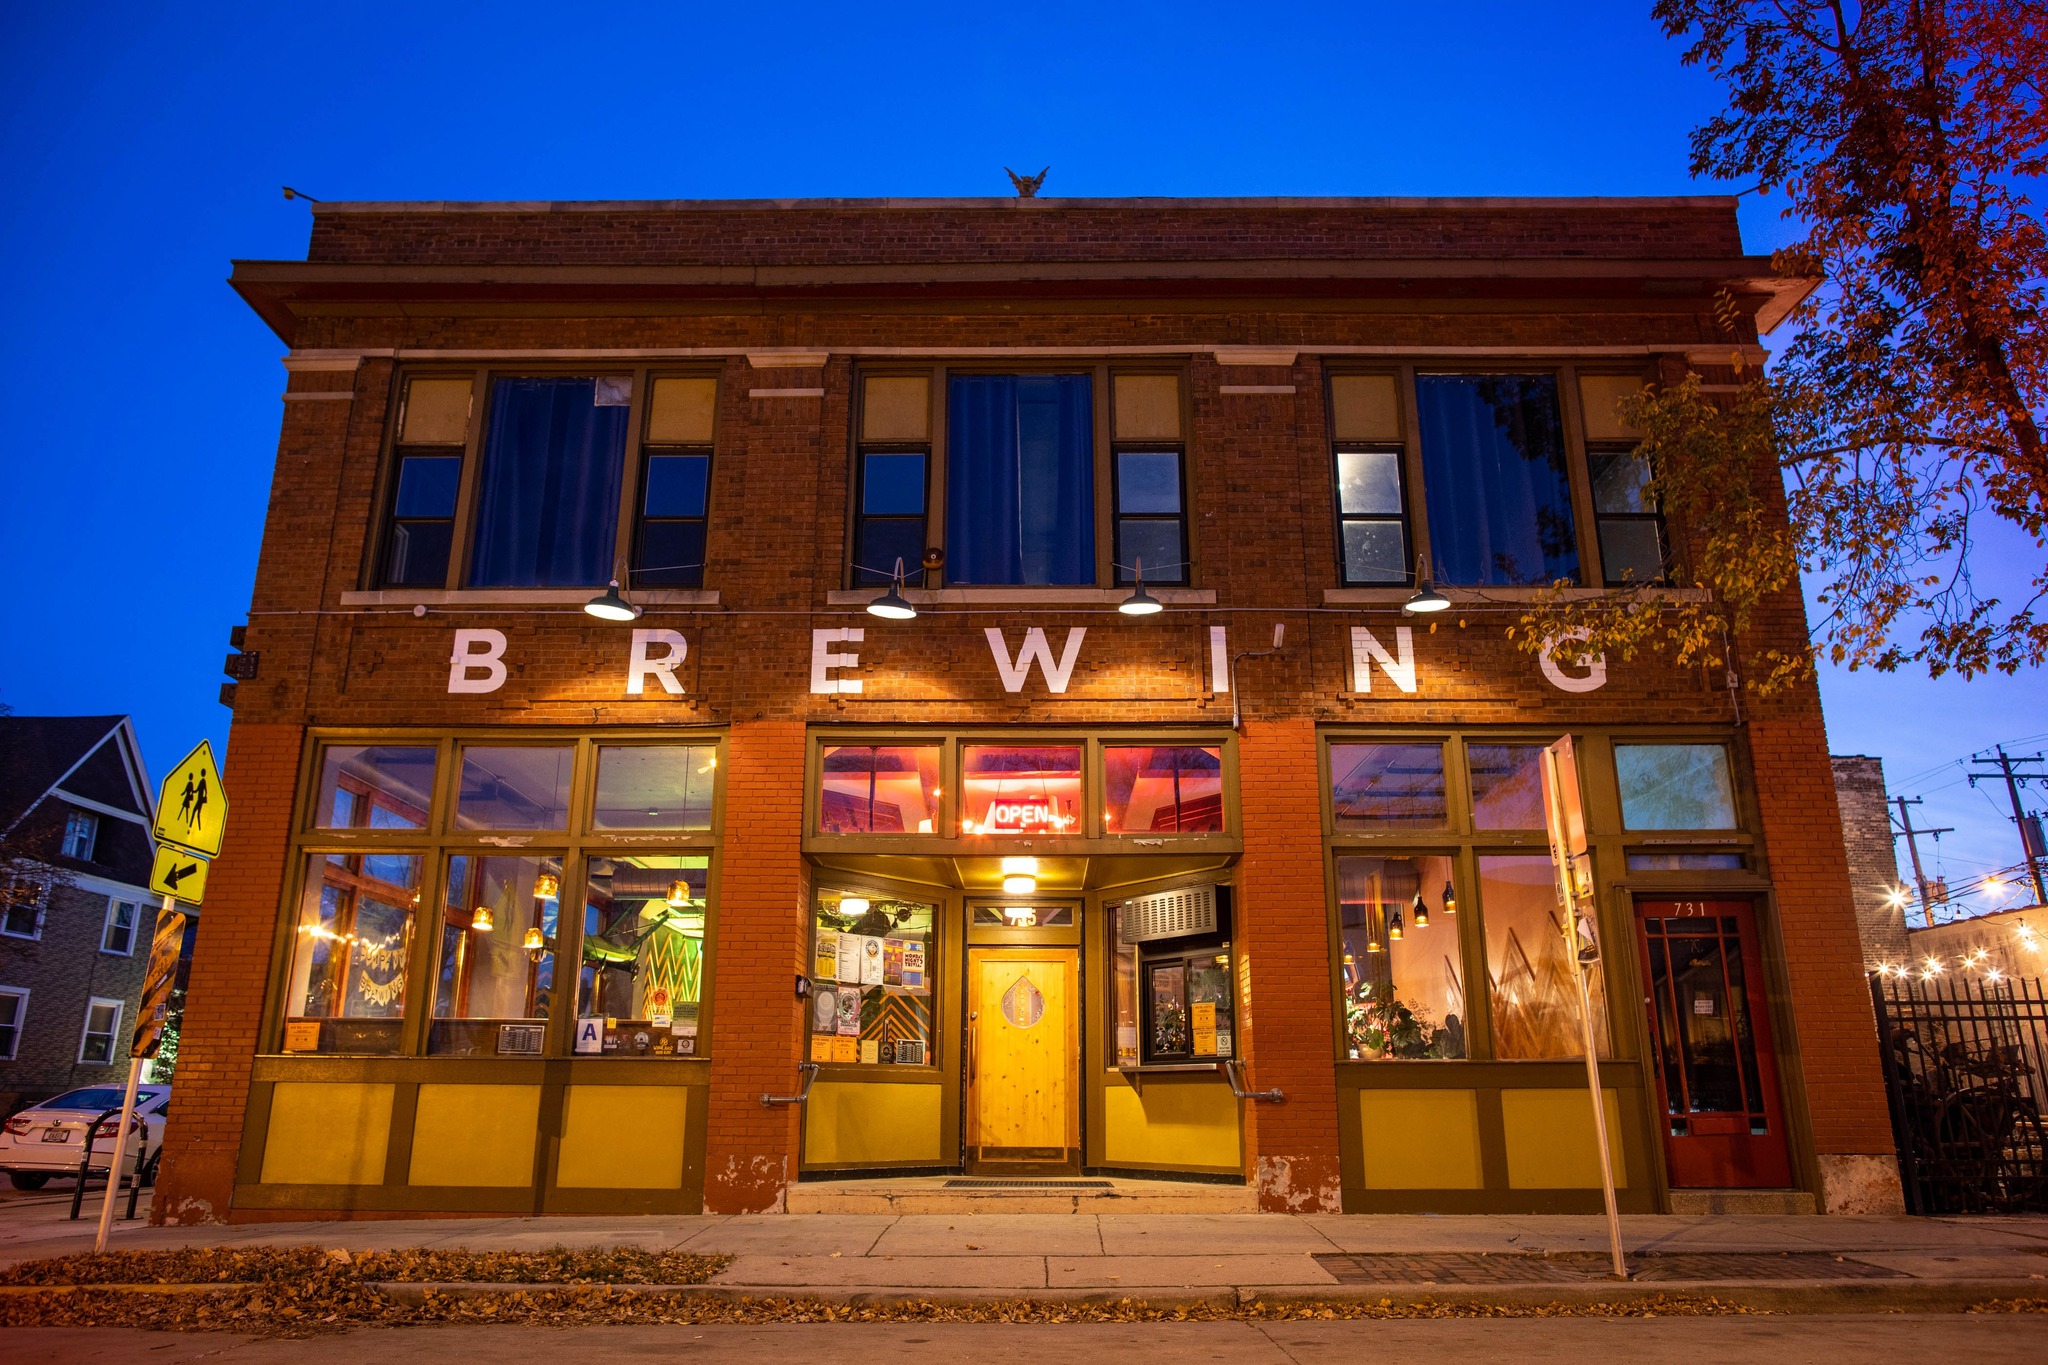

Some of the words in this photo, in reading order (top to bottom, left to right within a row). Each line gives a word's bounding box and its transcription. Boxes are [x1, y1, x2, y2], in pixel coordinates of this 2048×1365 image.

[447, 626, 1607, 694] BREWING
[995, 805, 1048, 824] OPEN
[1674, 902, 1705, 916] 731
[360, 976, 404, 1001] BREWING
[582, 1023, 598, 1041] A
